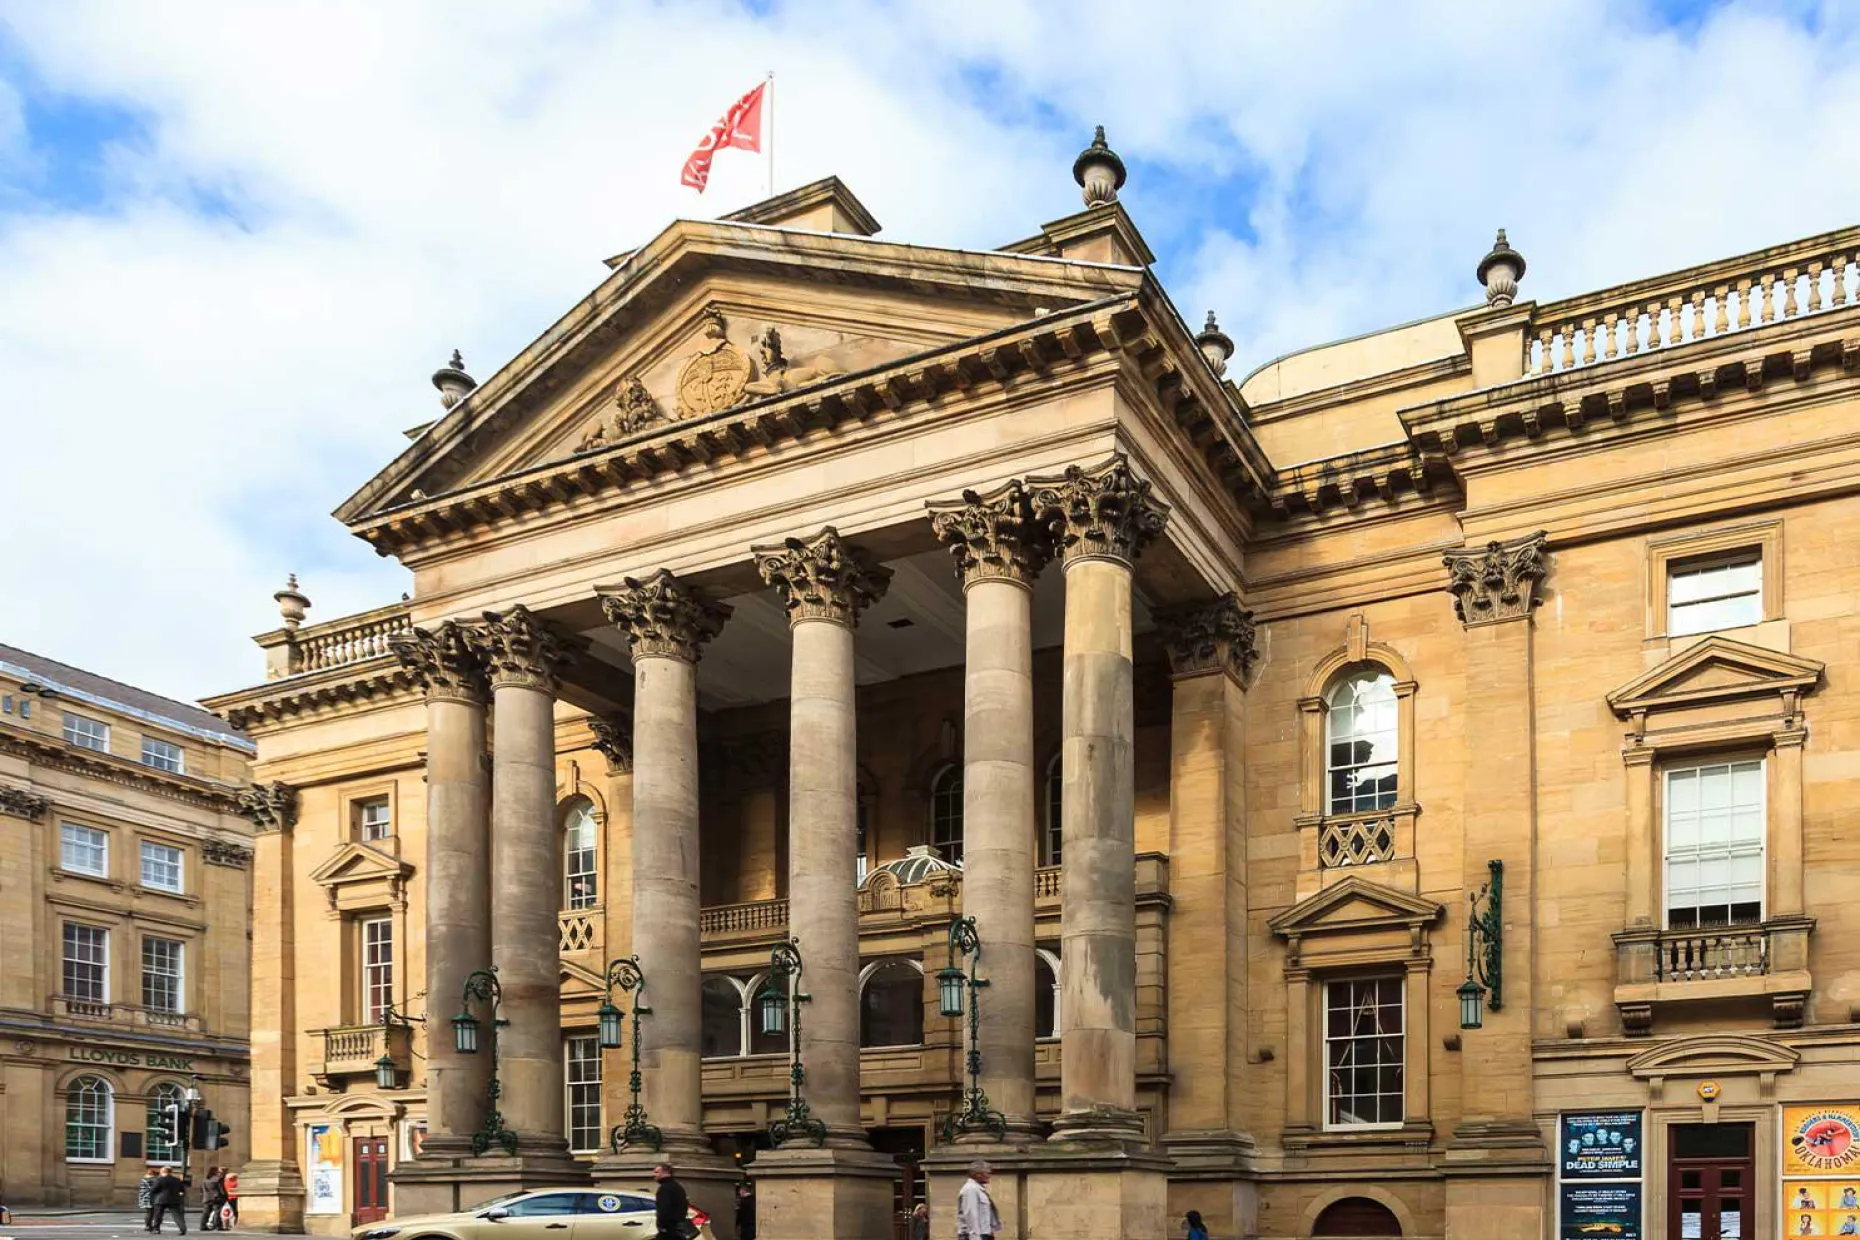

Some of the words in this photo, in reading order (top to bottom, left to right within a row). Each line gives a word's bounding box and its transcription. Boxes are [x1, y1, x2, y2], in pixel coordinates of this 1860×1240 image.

[69, 1047, 140, 1065] LLOYDS
[146, 1054, 193, 1070] BANK
[1566, 1161, 1596, 1170] DEAD
[1598, 1160, 1638, 1169] SIMPLE
